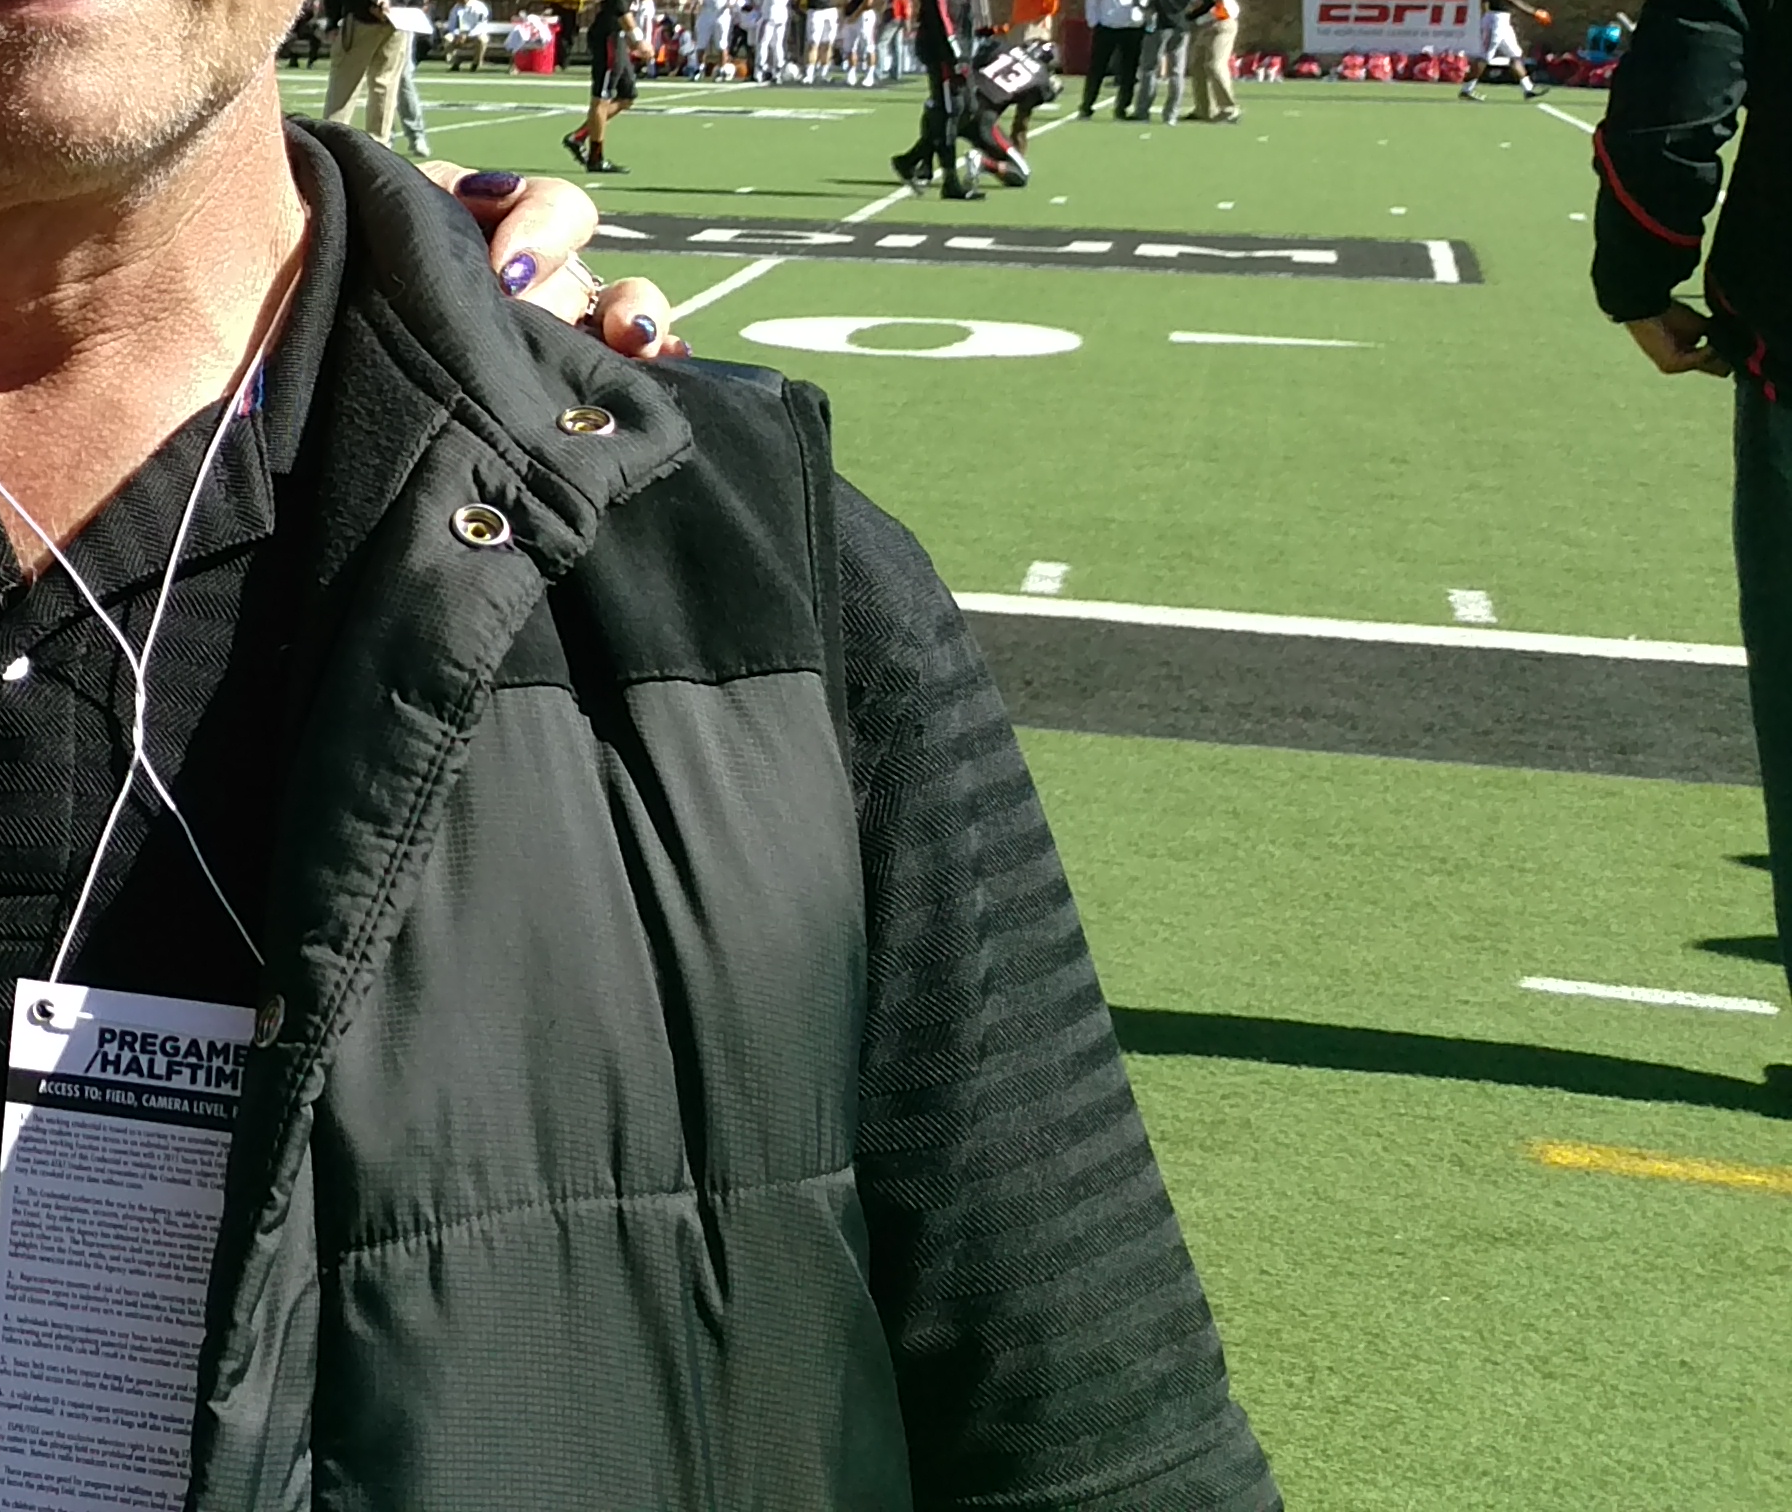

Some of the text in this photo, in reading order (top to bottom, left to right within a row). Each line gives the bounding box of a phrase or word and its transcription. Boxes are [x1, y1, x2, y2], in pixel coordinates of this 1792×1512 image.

[979, 54, 1032, 93] 13
[98, 1027, 249, 1064] PREGAME
[85, 1049, 246, 1090] /HALFTIM
[39, 1079, 80, 1099] ACCESS
[84, 1085, 103, 1101] TO:
[106, 1088, 139, 1107] FIELD,
[142, 1093, 190, 1113] CAMERA
[193, 1100, 228, 1120] LEVEL,
